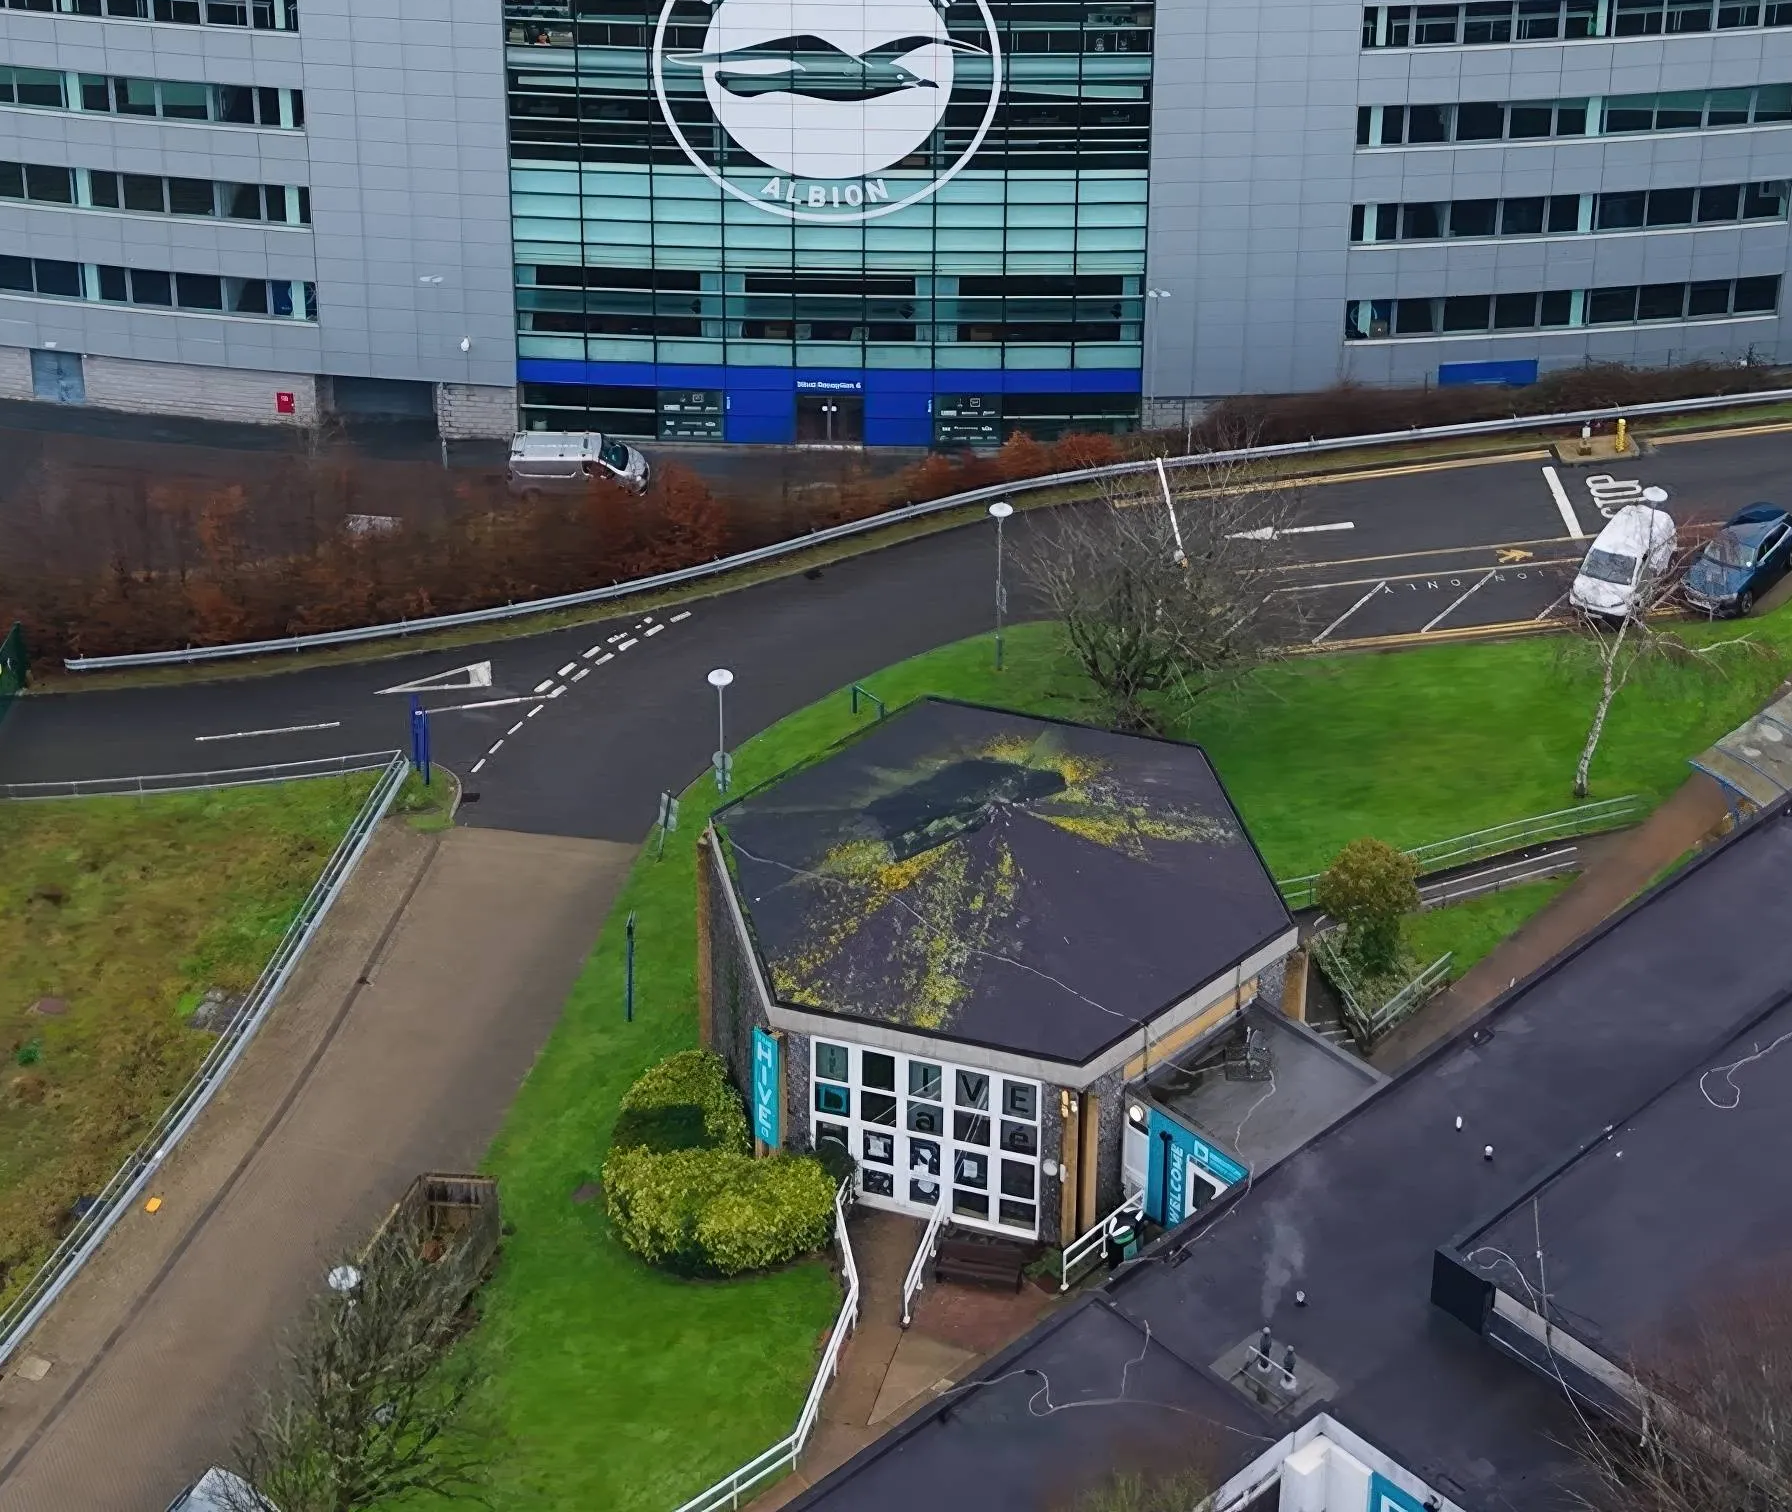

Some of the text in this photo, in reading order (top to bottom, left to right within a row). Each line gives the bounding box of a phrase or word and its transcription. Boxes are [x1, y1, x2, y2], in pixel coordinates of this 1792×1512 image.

[761, 177, 890, 208] ALBION
[1384, 578, 1461, 595] ONLY
[757, 1041, 773, 1128] HIVE
[1169, 1143, 1184, 1224] WELCOME
